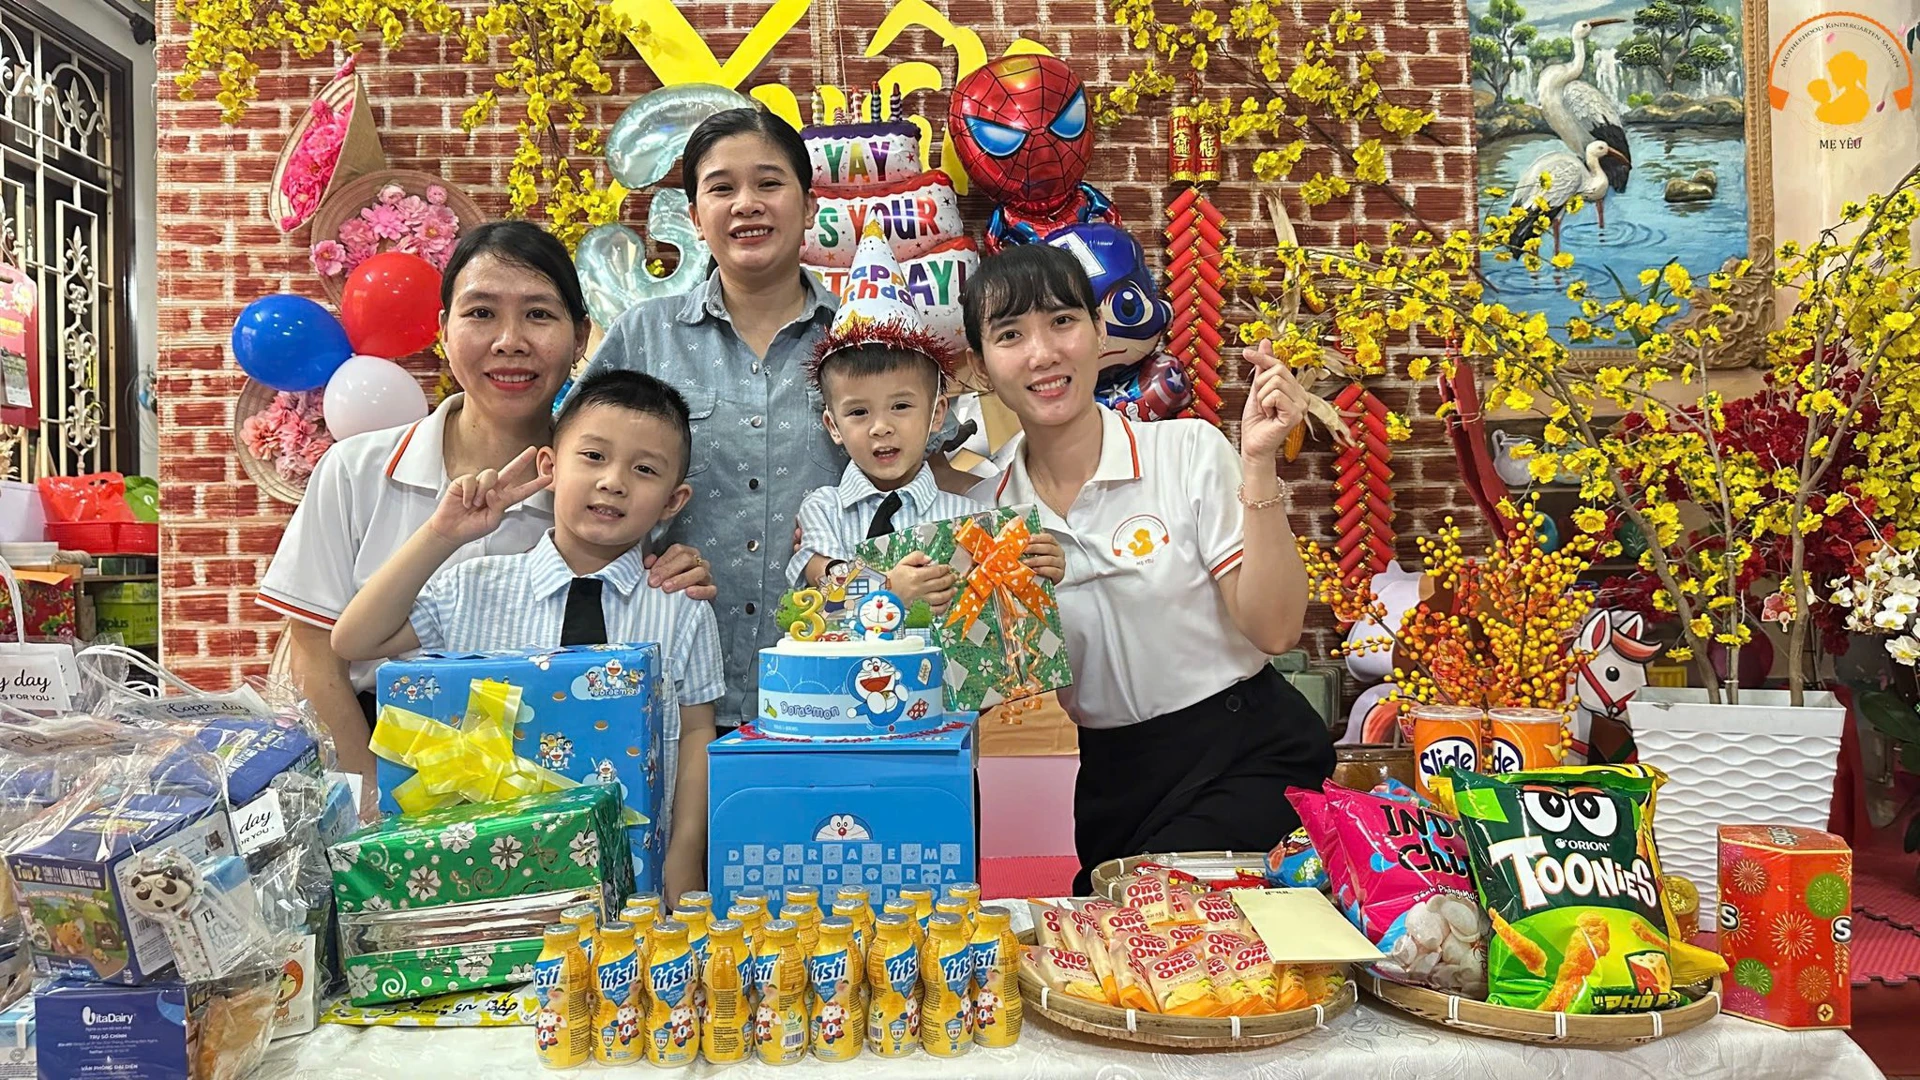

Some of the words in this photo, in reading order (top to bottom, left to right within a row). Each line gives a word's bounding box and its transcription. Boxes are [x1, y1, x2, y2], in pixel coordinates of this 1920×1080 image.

[823, 140, 891, 185] YAY
[846, 197, 940, 246] YOUR
[789, 587, 828, 641] 3
[14, 669, 51, 693] day
[9, 693, 29, 701] FOR
[780, 700, 840, 721] Doraemon
[1420, 745, 1473, 775] Slide
[239, 811, 273, 835] day
[251, 827, 270, 840] YOU
[1567, 839, 1609, 852] ORION
[1127, 881, 1162, 898] One
[1130, 892, 1165, 909] One
[1198, 899, 1232, 911] One
[1109, 912, 1145, 928] One
[1206, 909, 1239, 923] One
[1128, 936, 1168, 949] One
[1154, 952, 1194, 971] One
[1158, 960, 1198, 979] One
[82, 1006, 134, 1026] VitaDairy
